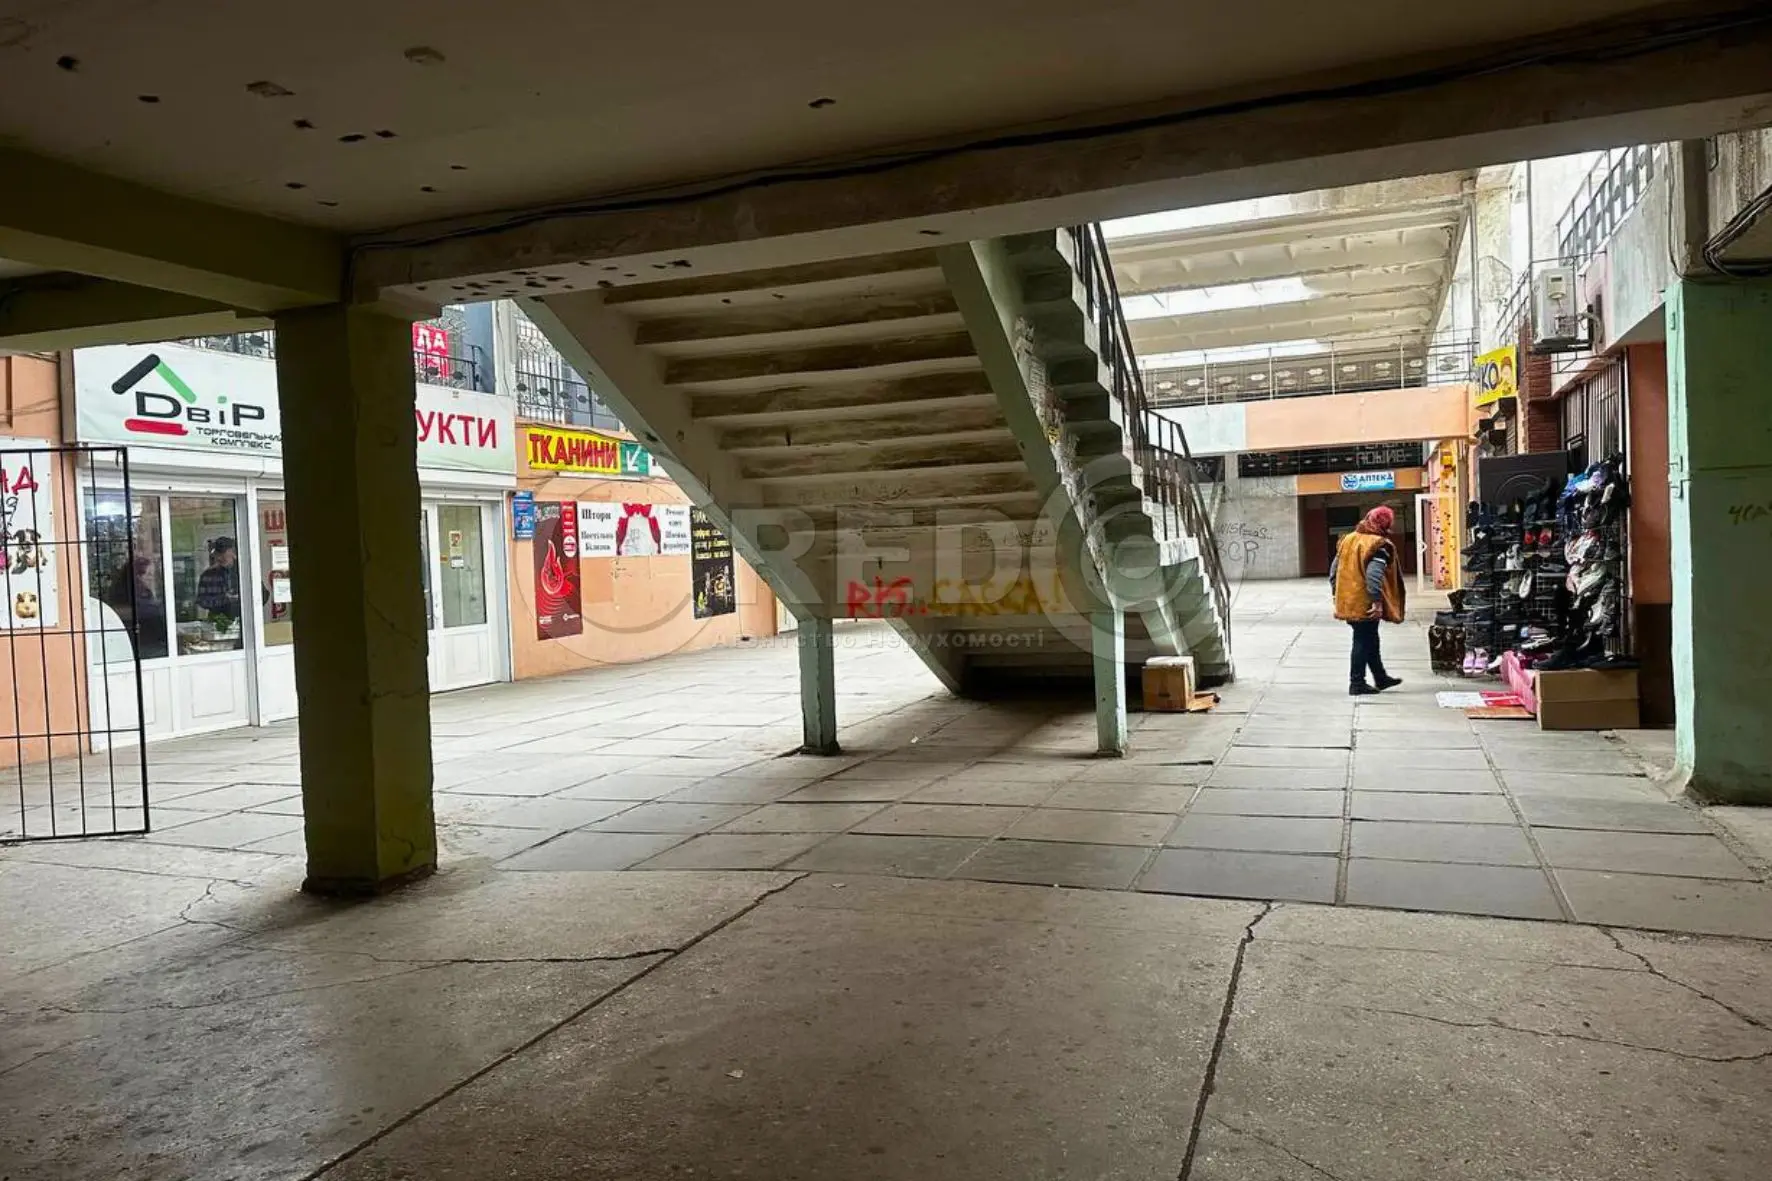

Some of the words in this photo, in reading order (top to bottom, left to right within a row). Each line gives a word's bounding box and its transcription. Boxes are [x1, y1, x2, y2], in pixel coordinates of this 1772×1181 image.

[211, 437, 272, 450] КОМПЛЕКС
[529, 433, 618, 470] ТКАНИНИ
[1359, 473, 1393, 482] АПТЕКА
[582, 508, 612, 523] Штори
